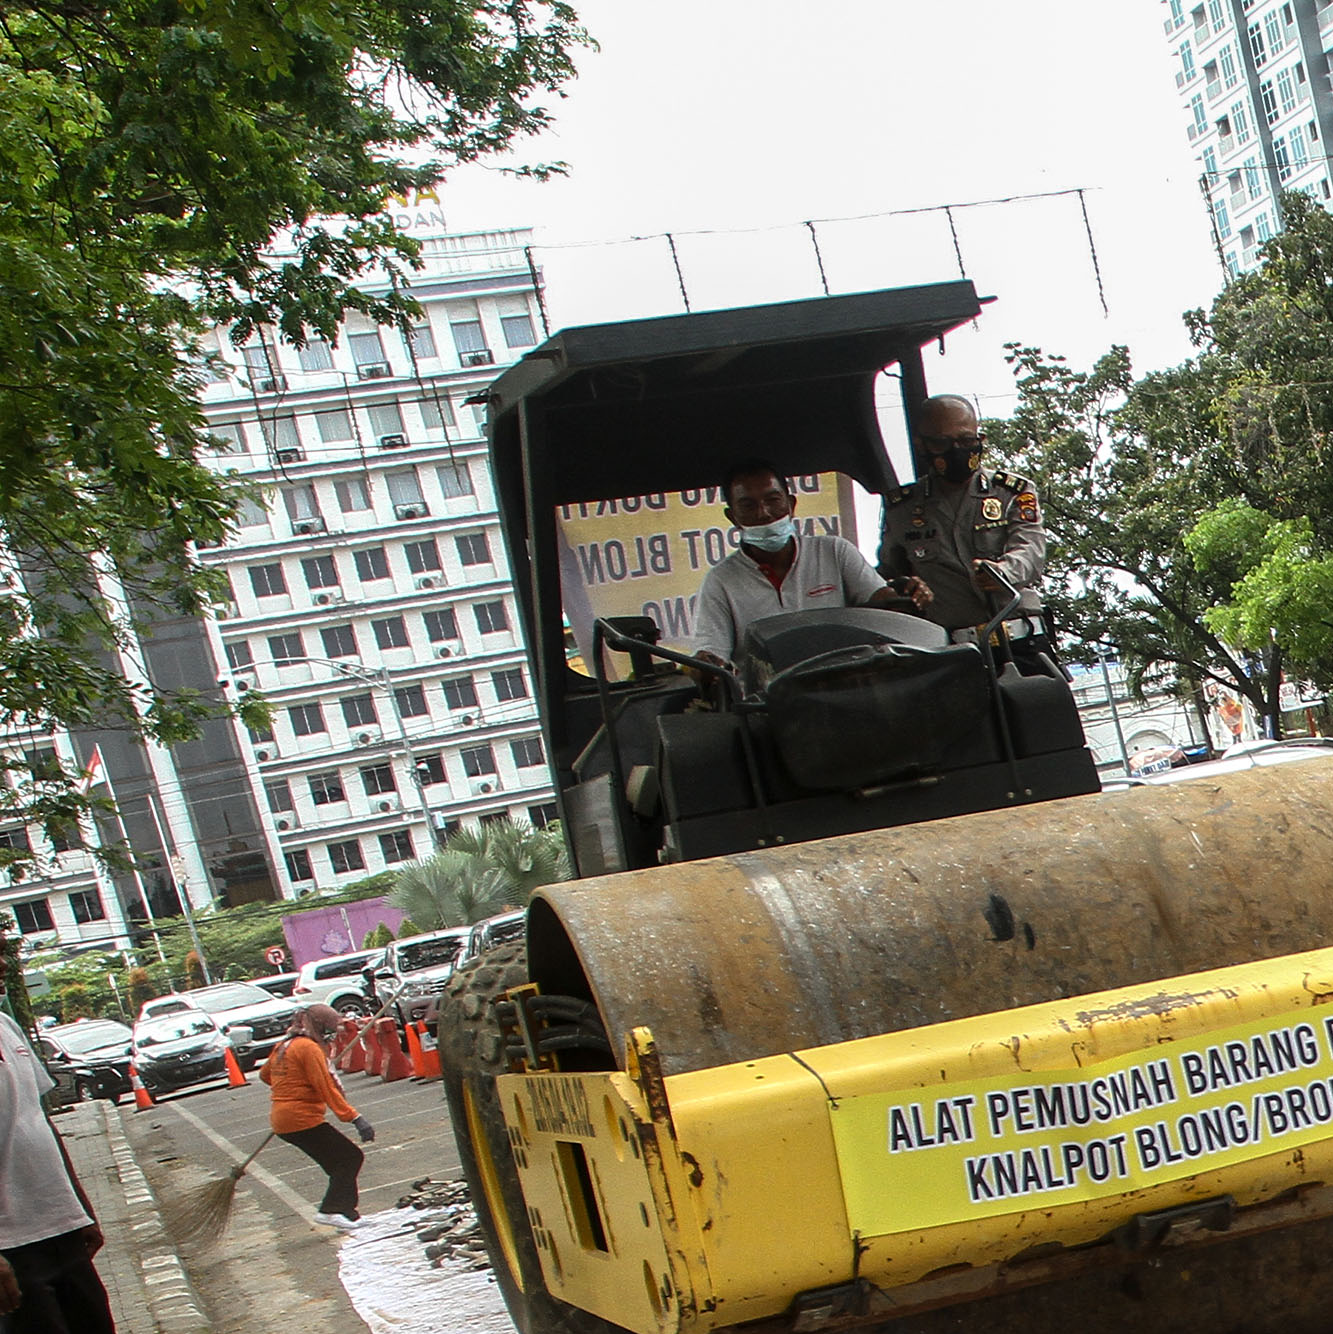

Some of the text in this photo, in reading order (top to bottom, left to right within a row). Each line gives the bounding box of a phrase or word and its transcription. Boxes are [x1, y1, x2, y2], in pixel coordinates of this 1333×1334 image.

[890, 1096, 976, 1153] ALAT
[986, 1057, 1177, 1138] PEMUSNAH
[1181, 1020, 1321, 1096] BARANG
[966, 1135, 1131, 1202] KNALPOT
